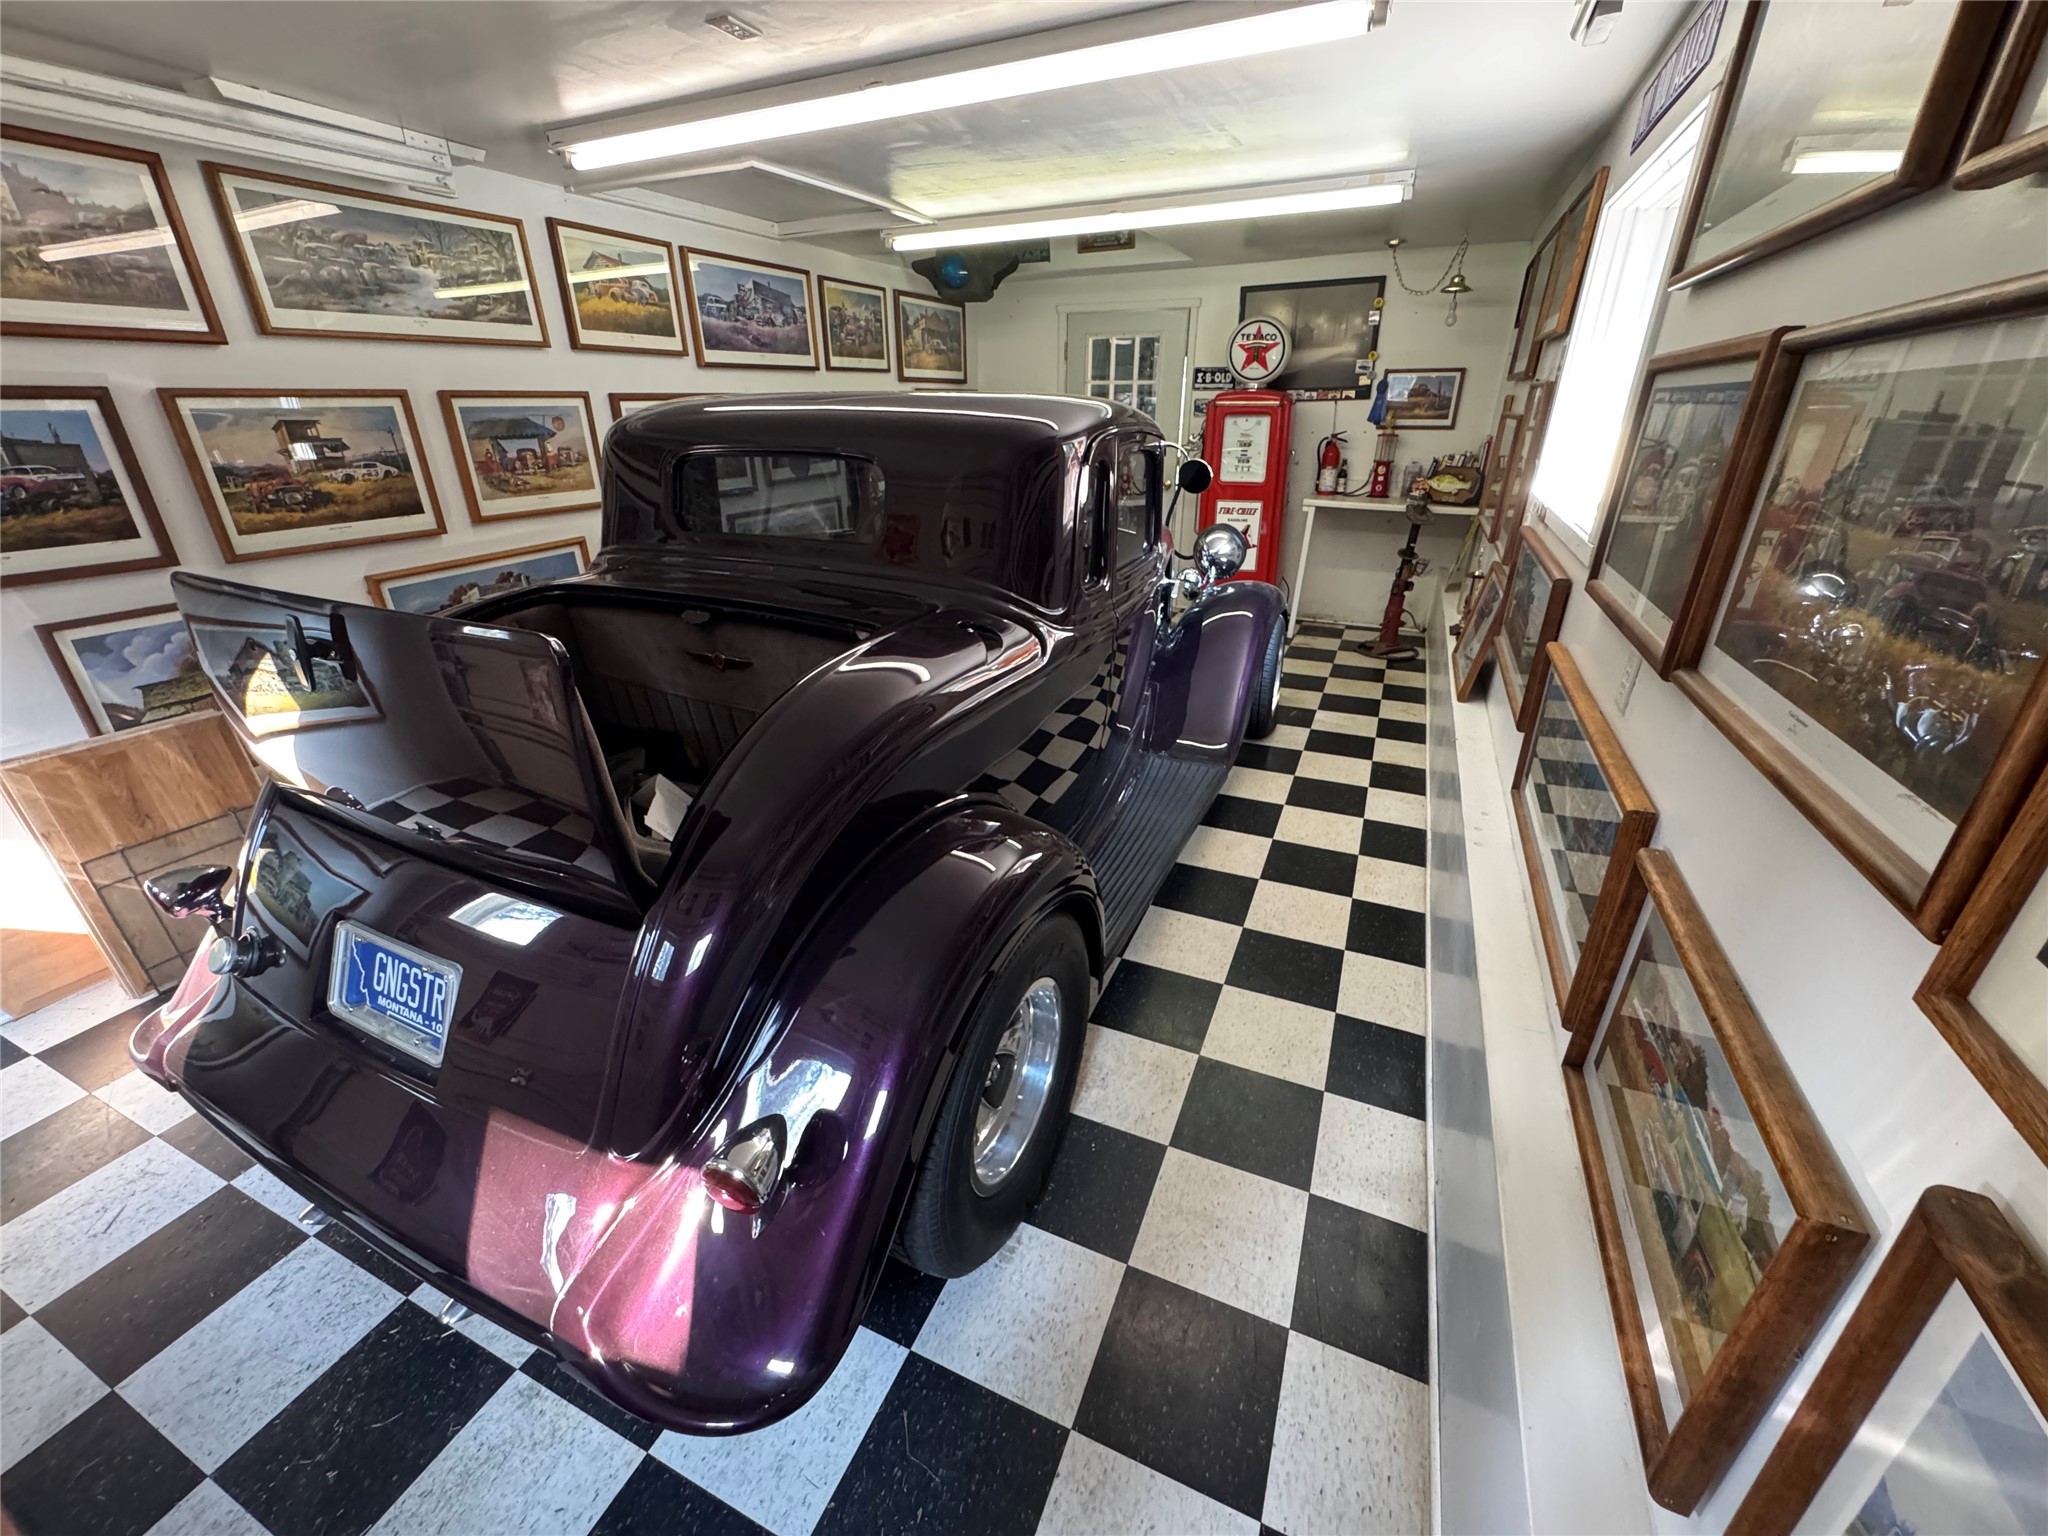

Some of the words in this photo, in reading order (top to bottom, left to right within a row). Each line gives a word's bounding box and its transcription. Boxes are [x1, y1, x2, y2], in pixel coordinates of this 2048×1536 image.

[1241, 333, 1278, 341] TEXACO
[373, 952, 446, 1021] GNGSTR
[377, 995, 424, 1026] MONTANA
[431, 1020, 443, 1033] 10
